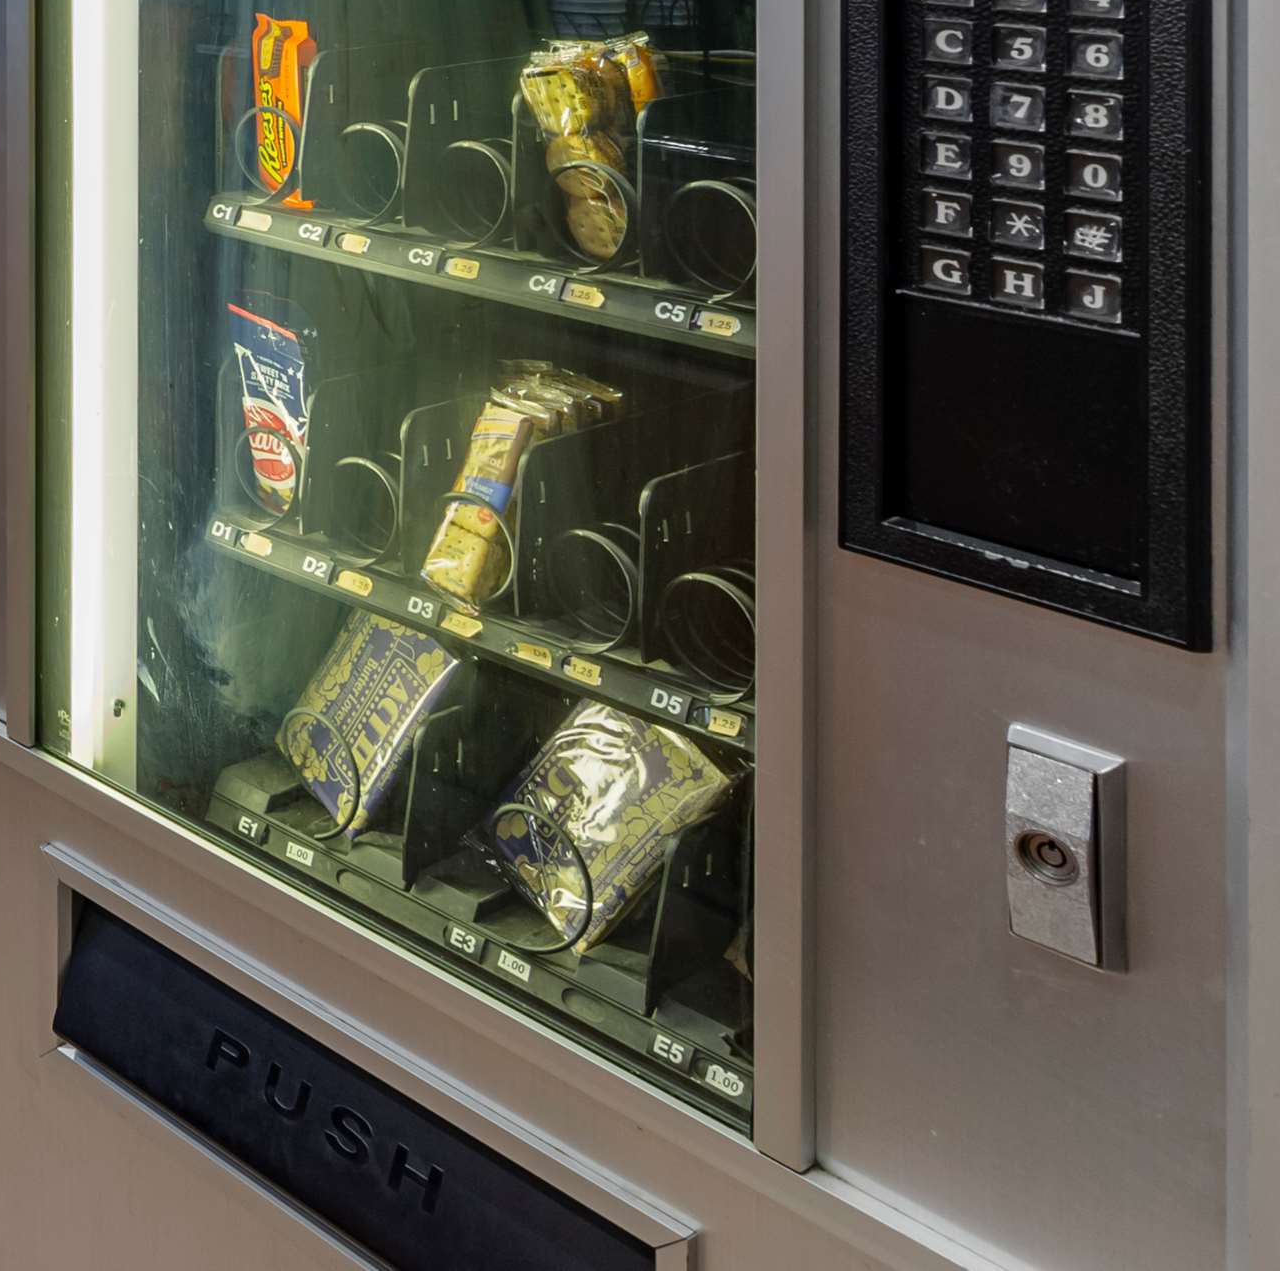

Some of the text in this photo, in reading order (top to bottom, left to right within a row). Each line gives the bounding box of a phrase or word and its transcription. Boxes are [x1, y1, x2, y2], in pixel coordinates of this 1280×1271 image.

[935, 29, 1109, 68] C 5 6
[935, 86, 1108, 129] D 7 8
[935, 145, 962, 169] E
[1009, 154, 1032, 177] 9
[212, 204, 233, 220] C1
[935, 202, 960, 225] F
[298, 223, 323, 241] C2
[408, 248, 434, 266] C3
[528, 275, 592, 301] C4 1.25
[932, 259, 1105, 310] G H J
[654, 301, 732, 331] C5 1.25
[211, 520, 233, 541] D1
[302, 555, 328, 578] D2
[407, 596, 434, 619] D3
[572, 664, 594, 679] 1.25
[368, 677, 408, 748] ACT
[650, 688, 736, 731] D5 1.25
[237, 815, 309, 861] E1 1.00
[450, 927, 526, 975] E3 1.00
[653, 1034, 740, 1094] E5 1.00
[205, 1027, 444, 1216] PUSH
